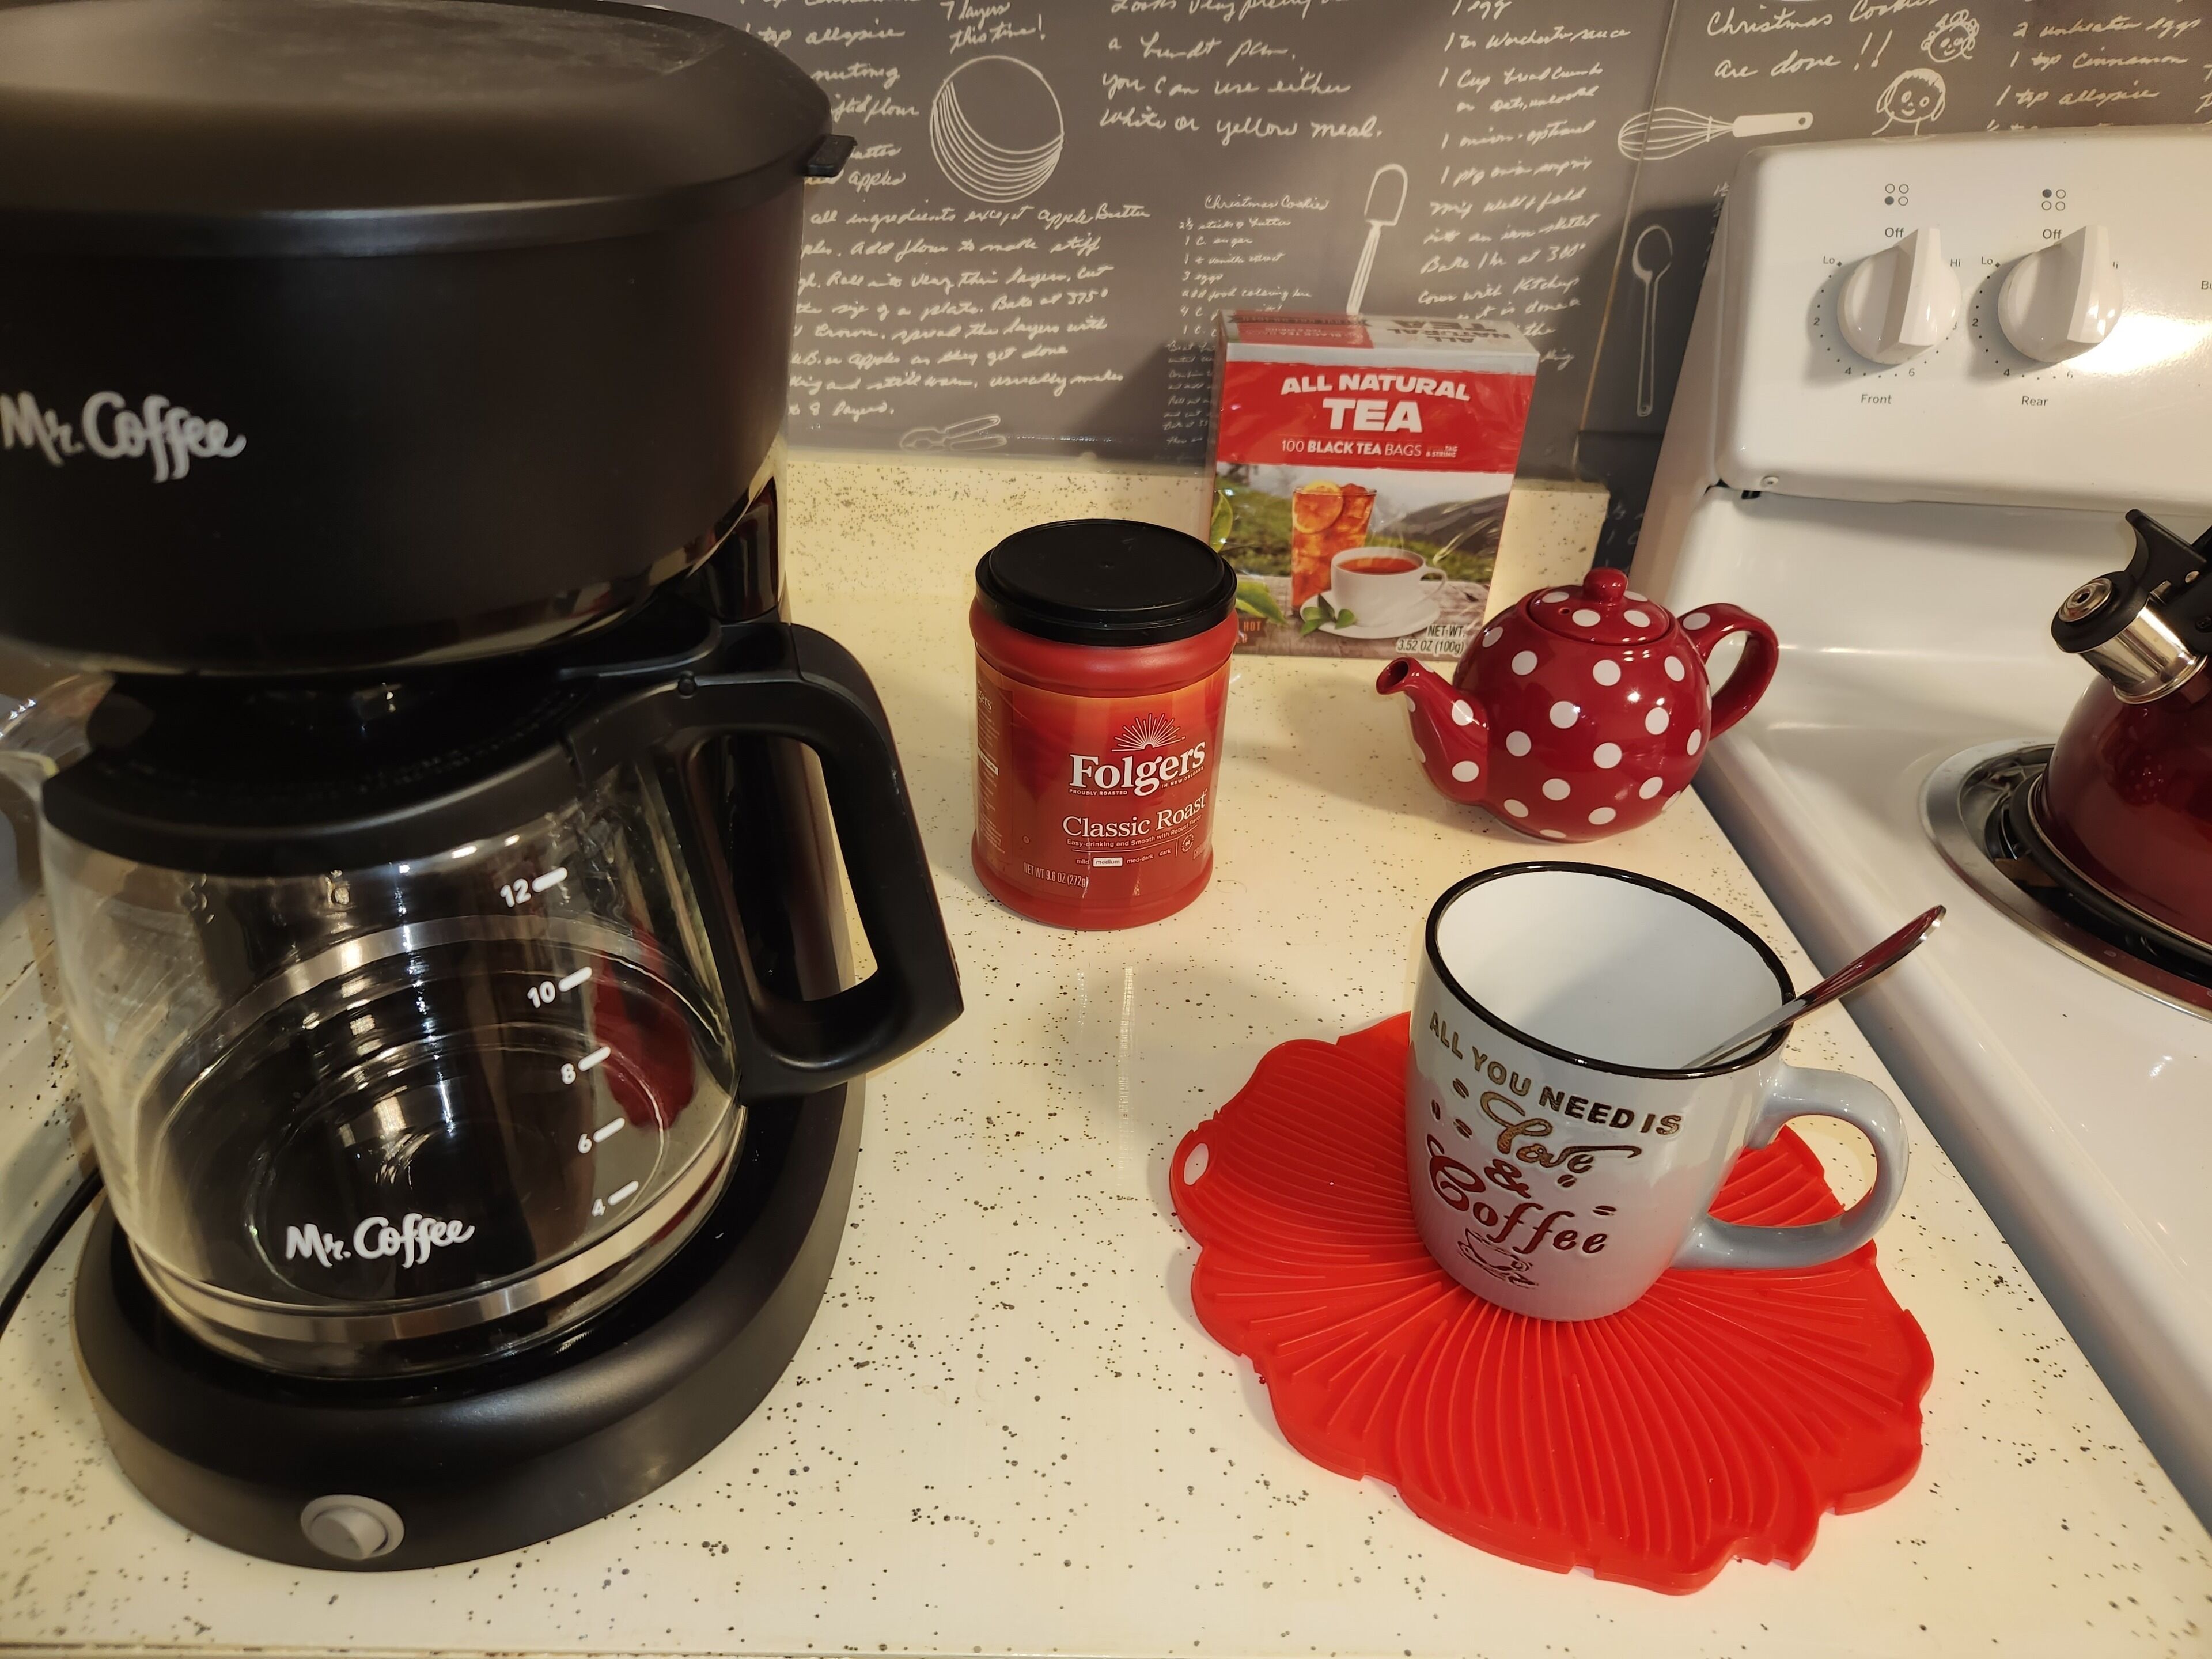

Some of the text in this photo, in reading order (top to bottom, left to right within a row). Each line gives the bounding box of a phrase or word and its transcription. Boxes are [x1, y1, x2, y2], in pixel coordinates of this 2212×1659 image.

[1706, 4, 1833, 36] Christmas
[2145, 18, 2202, 39] eggs
[1108, 37, 1122, 50] a
[1715, 59, 1758, 78] are
[1770, 49, 1842, 77] done
[1103, 72, 1146, 100] you
[1214, 81, 1260, 95] use
[1267, 66, 1351, 95] either
[1216, 117, 1298, 146] yellow
[1205, 194, 1330, 211] Christmas Cookies
[846, 199, 956, 233] ingredients
[964, 205, 1035, 226] except
[1885, 228, 1904, 238] Off
[2042, 229, 2062, 240] Off
[895, 238, 949, 263] flour
[957, 238, 975, 252] to
[1823, 256, 1835, 265] Lo
[1981, 256, 1994, 265] Lo
[1950, 259, 1961, 268] Hi
[1181, 271, 1224, 285] 3 eggs
[964, 322, 999, 339] the
[1067, 315, 1108, 332] with
[1813, 318, 1820, 327] 2
[1972, 318, 1979, 327] 2
[987, 347, 1017, 367] get
[1022, 344, 1069, 359] done
[825, 377, 862, 391] and
[866, 370, 922, 391] still
[1844, 367, 1852, 375] 4
[1908, 368, 1915, 377] 6
[2003, 369, 2010, 377] 4
[1281, 374, 1471, 401] ALL NATURAL
[810, 401, 821, 416] 8
[1861, 393, 1892, 404] Front
[2022, 395, 2048, 406] Rear
[1323, 397, 1423, 433] TEA
[82, 390, 247, 483] Coffee
[1282, 440, 1305, 452] 100
[1307, 441, 1354, 454] BLACK
[1356, 443, 1382, 456] TEA
[1385, 444, 1422, 457] BAGS
[1243, 621, 1262, 632] HOT
[1428, 625, 1446, 637] NET
[1397, 639, 1464, 655] 3.52 OZ (100g)
[1069, 741, 1206, 797] Folgers
[1170, 778, 1183, 786] NEW
[1184, 766, 1204, 781] ORLEANS
[1062, 790, 1206, 838] Classic Roast
[1067, 839, 1115, 849] Easy-drinking
[1131, 835, 1156, 846] Smooth
[1157, 831, 1169, 840] with
[1171, 823, 1189, 836] Robust
[1189, 813, 1202, 826] Flavor
[1127, 854, 1154, 864] med-dark
[1159, 848, 1172, 857] dark
[1024, 862, 1089, 890] NET WT 9.6 OZ (272g)
[500, 878, 530, 907] 12
[528, 981, 556, 1008] 10
[560, 1062, 577, 1084] 8
[1429, 1010, 1682, 1135] ALL YOU NEED IS
[1480, 1091, 1642, 1174] Love
[578, 1134, 593, 1153] 6
[1484, 1158, 1531, 1199] &
[1427, 1134, 1608, 1255] Coffee
[592, 1198, 606, 1216] 4
[286, 1213, 475, 1269] Mr. Coffee
